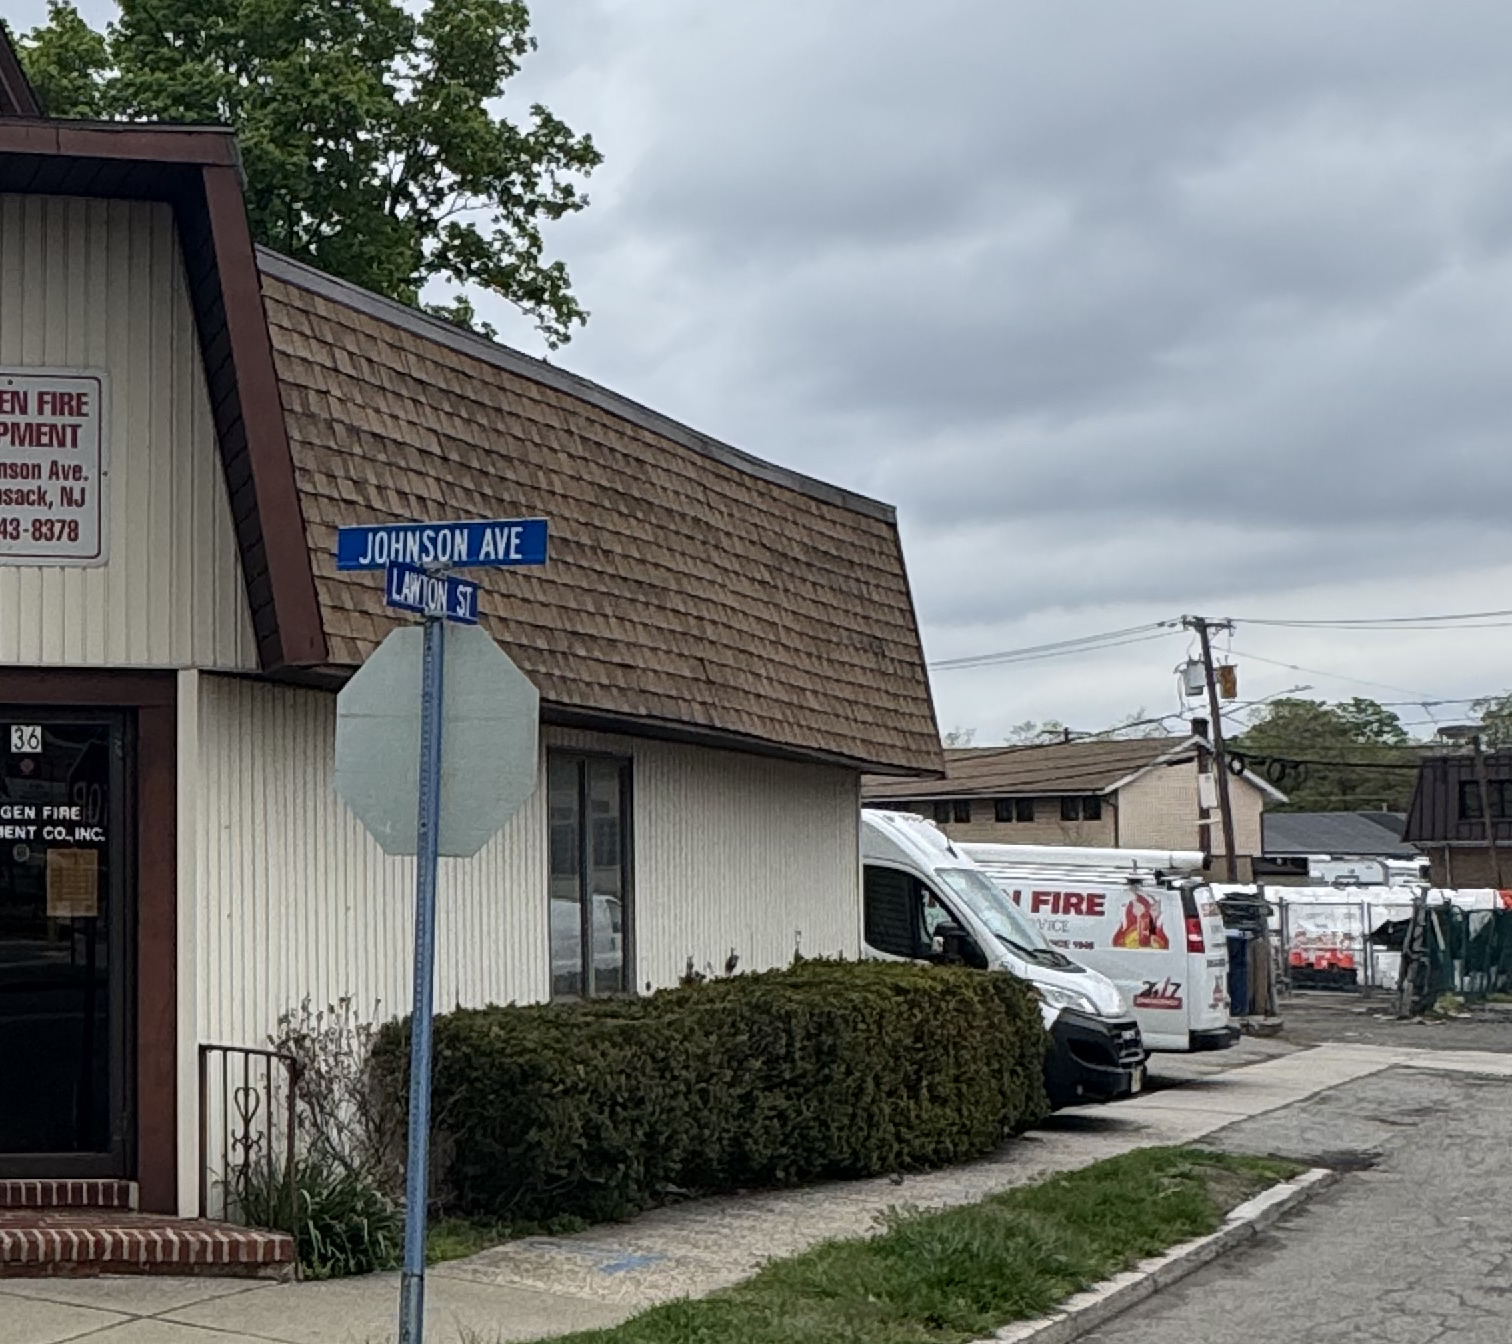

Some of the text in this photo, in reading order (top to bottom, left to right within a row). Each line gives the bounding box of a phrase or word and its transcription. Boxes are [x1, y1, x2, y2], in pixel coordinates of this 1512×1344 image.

[37, 391, 90, 417] FIRE
[48, 460, 90, 482] Ave.
[60, 486, 86, 508] NJ
[358, 526, 524, 565] JOHNSON AVE
[391, 567, 474, 619] LAWTON ST
[13, 726, 40, 751] 36
[42, 806, 82, 821] FIRE
[1031, 890, 1106, 917] FIRE
